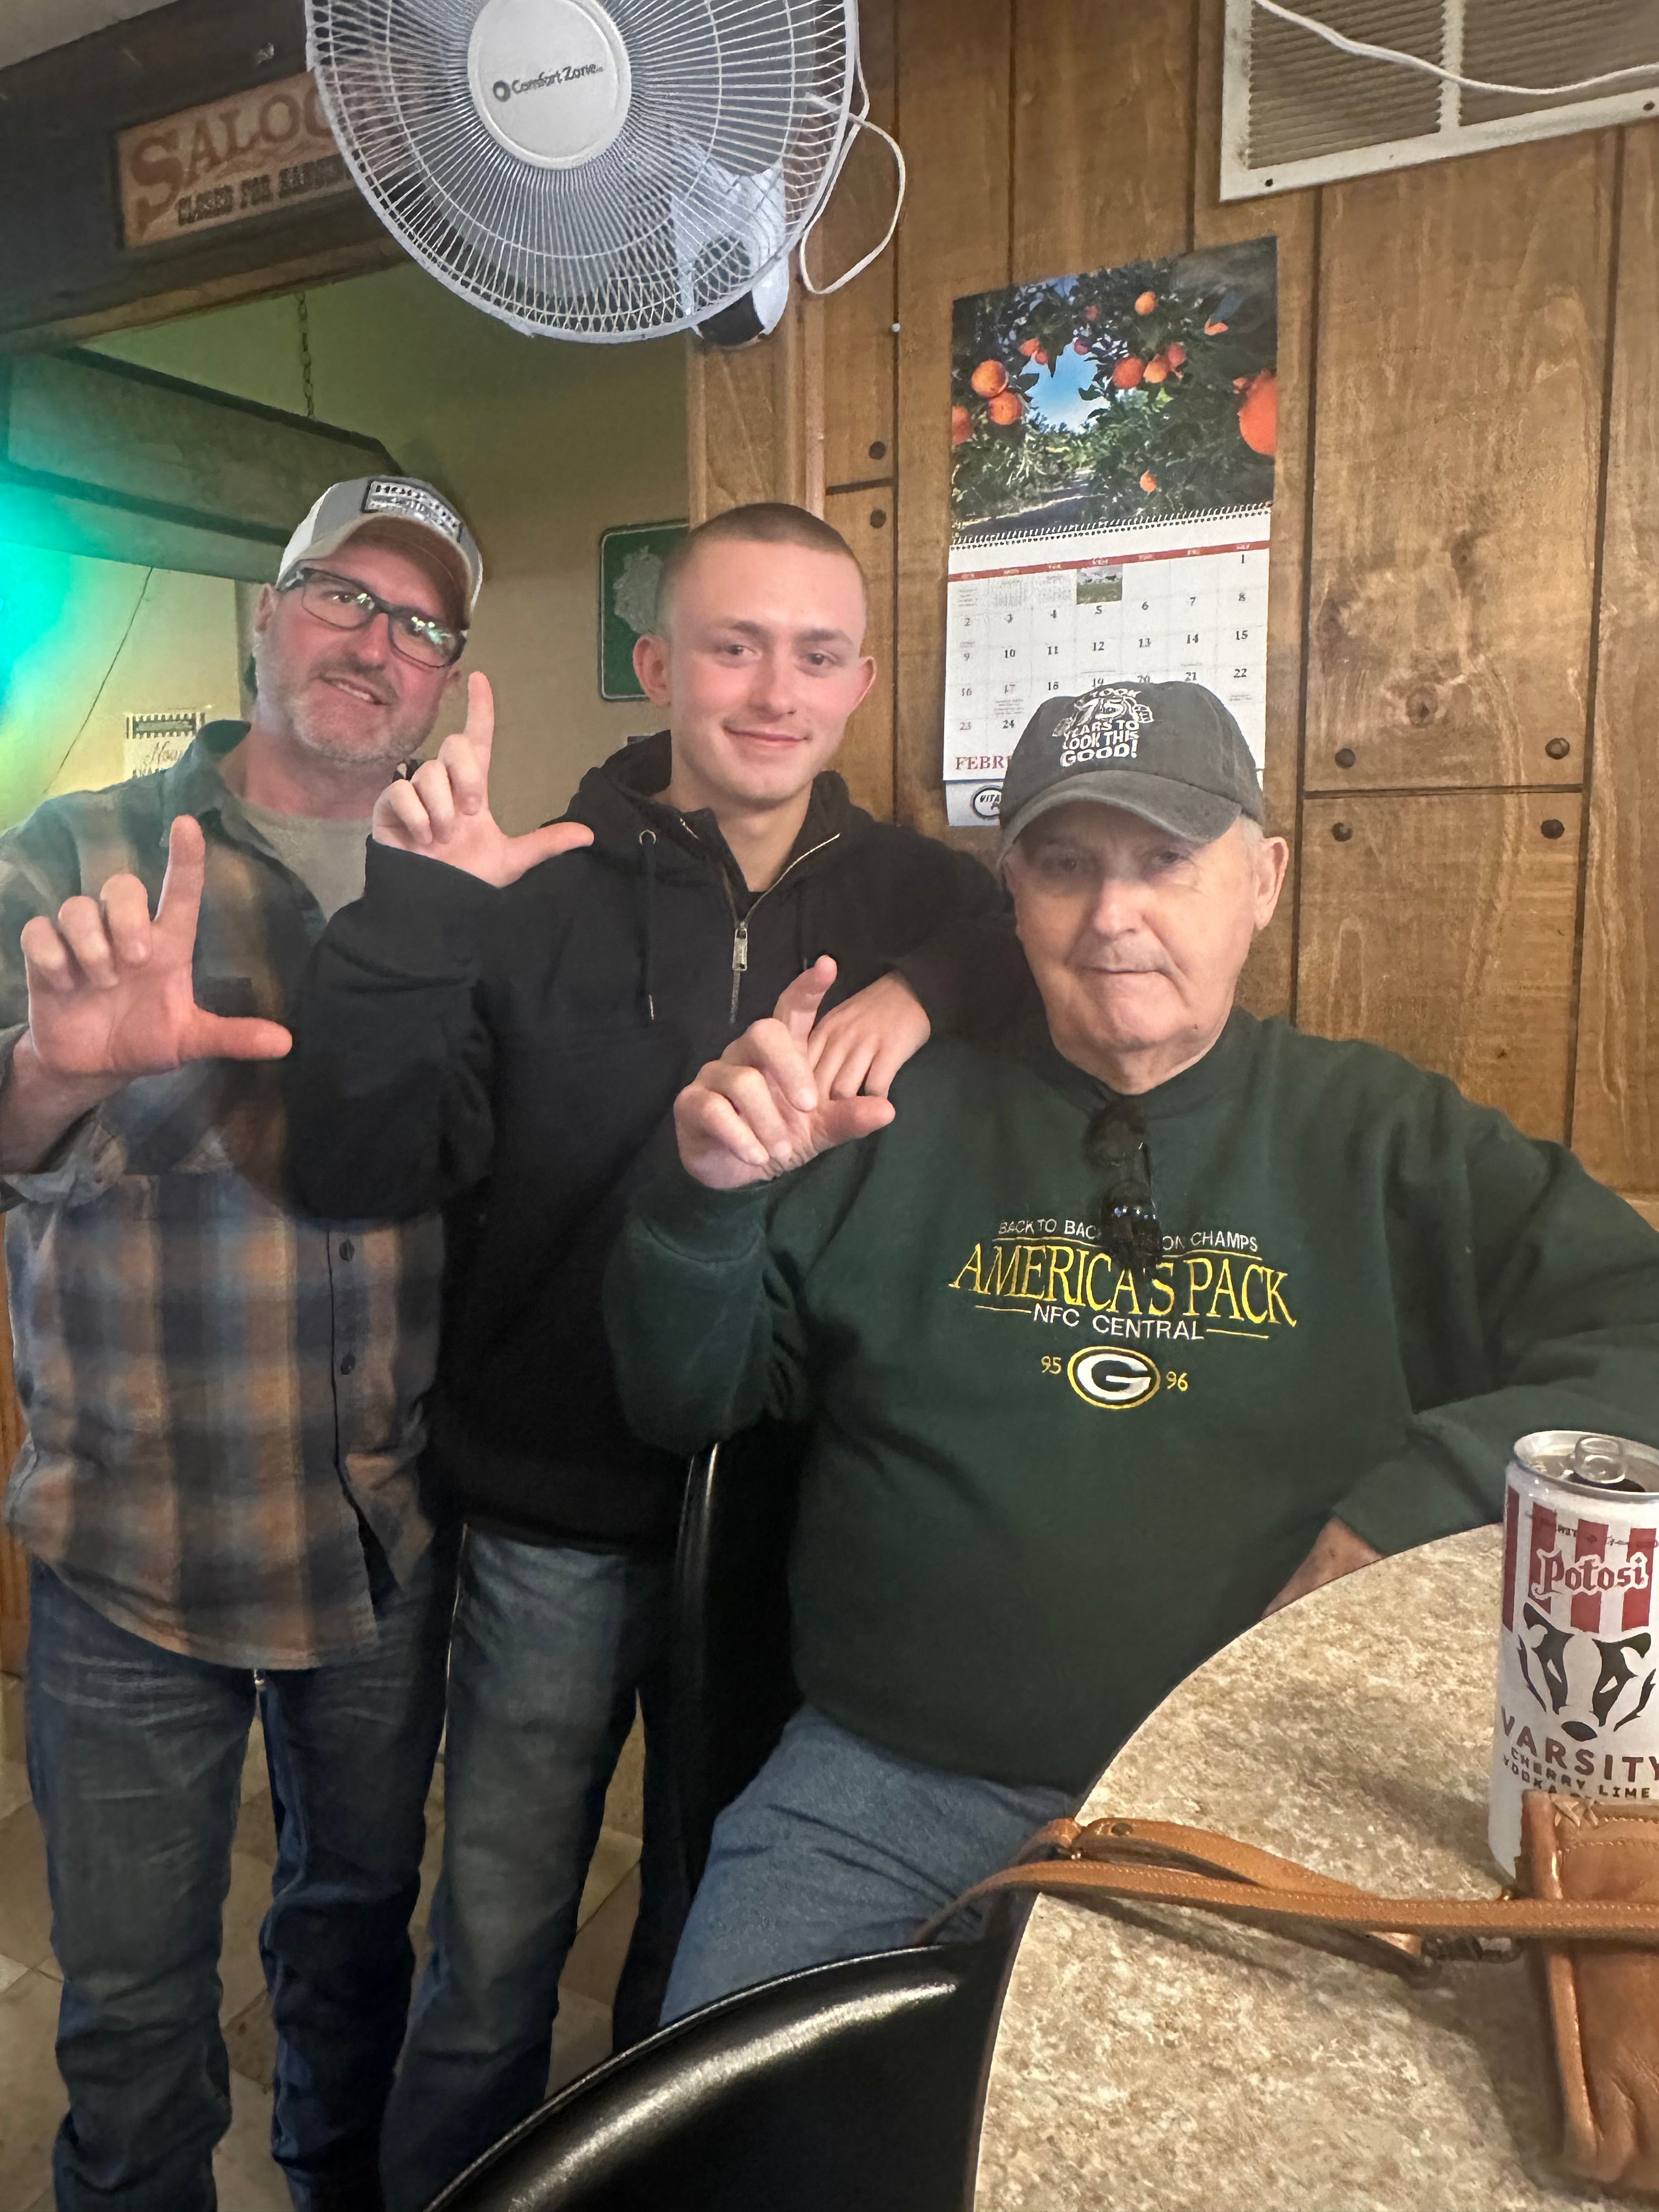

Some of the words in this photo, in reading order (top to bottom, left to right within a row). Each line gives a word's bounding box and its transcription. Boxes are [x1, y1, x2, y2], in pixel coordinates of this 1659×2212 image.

[512, 72, 562, 94] Comfort
[562, 64, 596, 81] Zone
[1241, 554, 1245, 564] 1
[964, 618, 970, 627] 2
[1094, 605, 1102, 614] 5
[1142, 601, 1149, 611] 6
[1190, 597, 1196, 606] 7
[1238, 592, 1246, 602] 8
[963, 653, 970, 661] 9
[1005, 649, 1015, 658] 10
[1047, 646, 1058, 655] 11
[1092, 641, 1105, 651] 12
[1138, 637, 1151, 648] 13
[1187, 634, 1199, 644] 14
[1235, 630, 1248, 640] 15
[1005, 684, 1015, 694] 17
[1184, 672, 1197, 681] 21
[1233, 668, 1248, 678] 22
[960, 722, 971, 731] 23
[1115, 719, 1139, 731] TO
[1060, 739, 1138, 767] GOOD!
[1063, 732, 1101, 750] LOOK
[1104, 730, 1139, 746] THIS
[955, 755, 1012, 770] FEBR
[998, 1220, 1035, 1234] BACK
[1037, 1218, 1057, 1233] TO
[1064, 1220, 1102, 1239] BAC
[1190, 1231, 1258, 1252] CHAMPS
[1183, 1257, 1297, 1327] PACK
[1034, 1302, 1080, 1327] NFC
[1092, 1314, 1205, 1340] CENTRAL
[1041, 1356, 1062, 1375] 95
[1076, 1353, 1152, 1401] G
[1166, 1371, 1189, 1392] 96
[1534, 1549, 1645, 1594] Potosi
[1511, 1747, 1585, 1789] CHERRY
[1599, 1785, 1651, 1798] LIME
